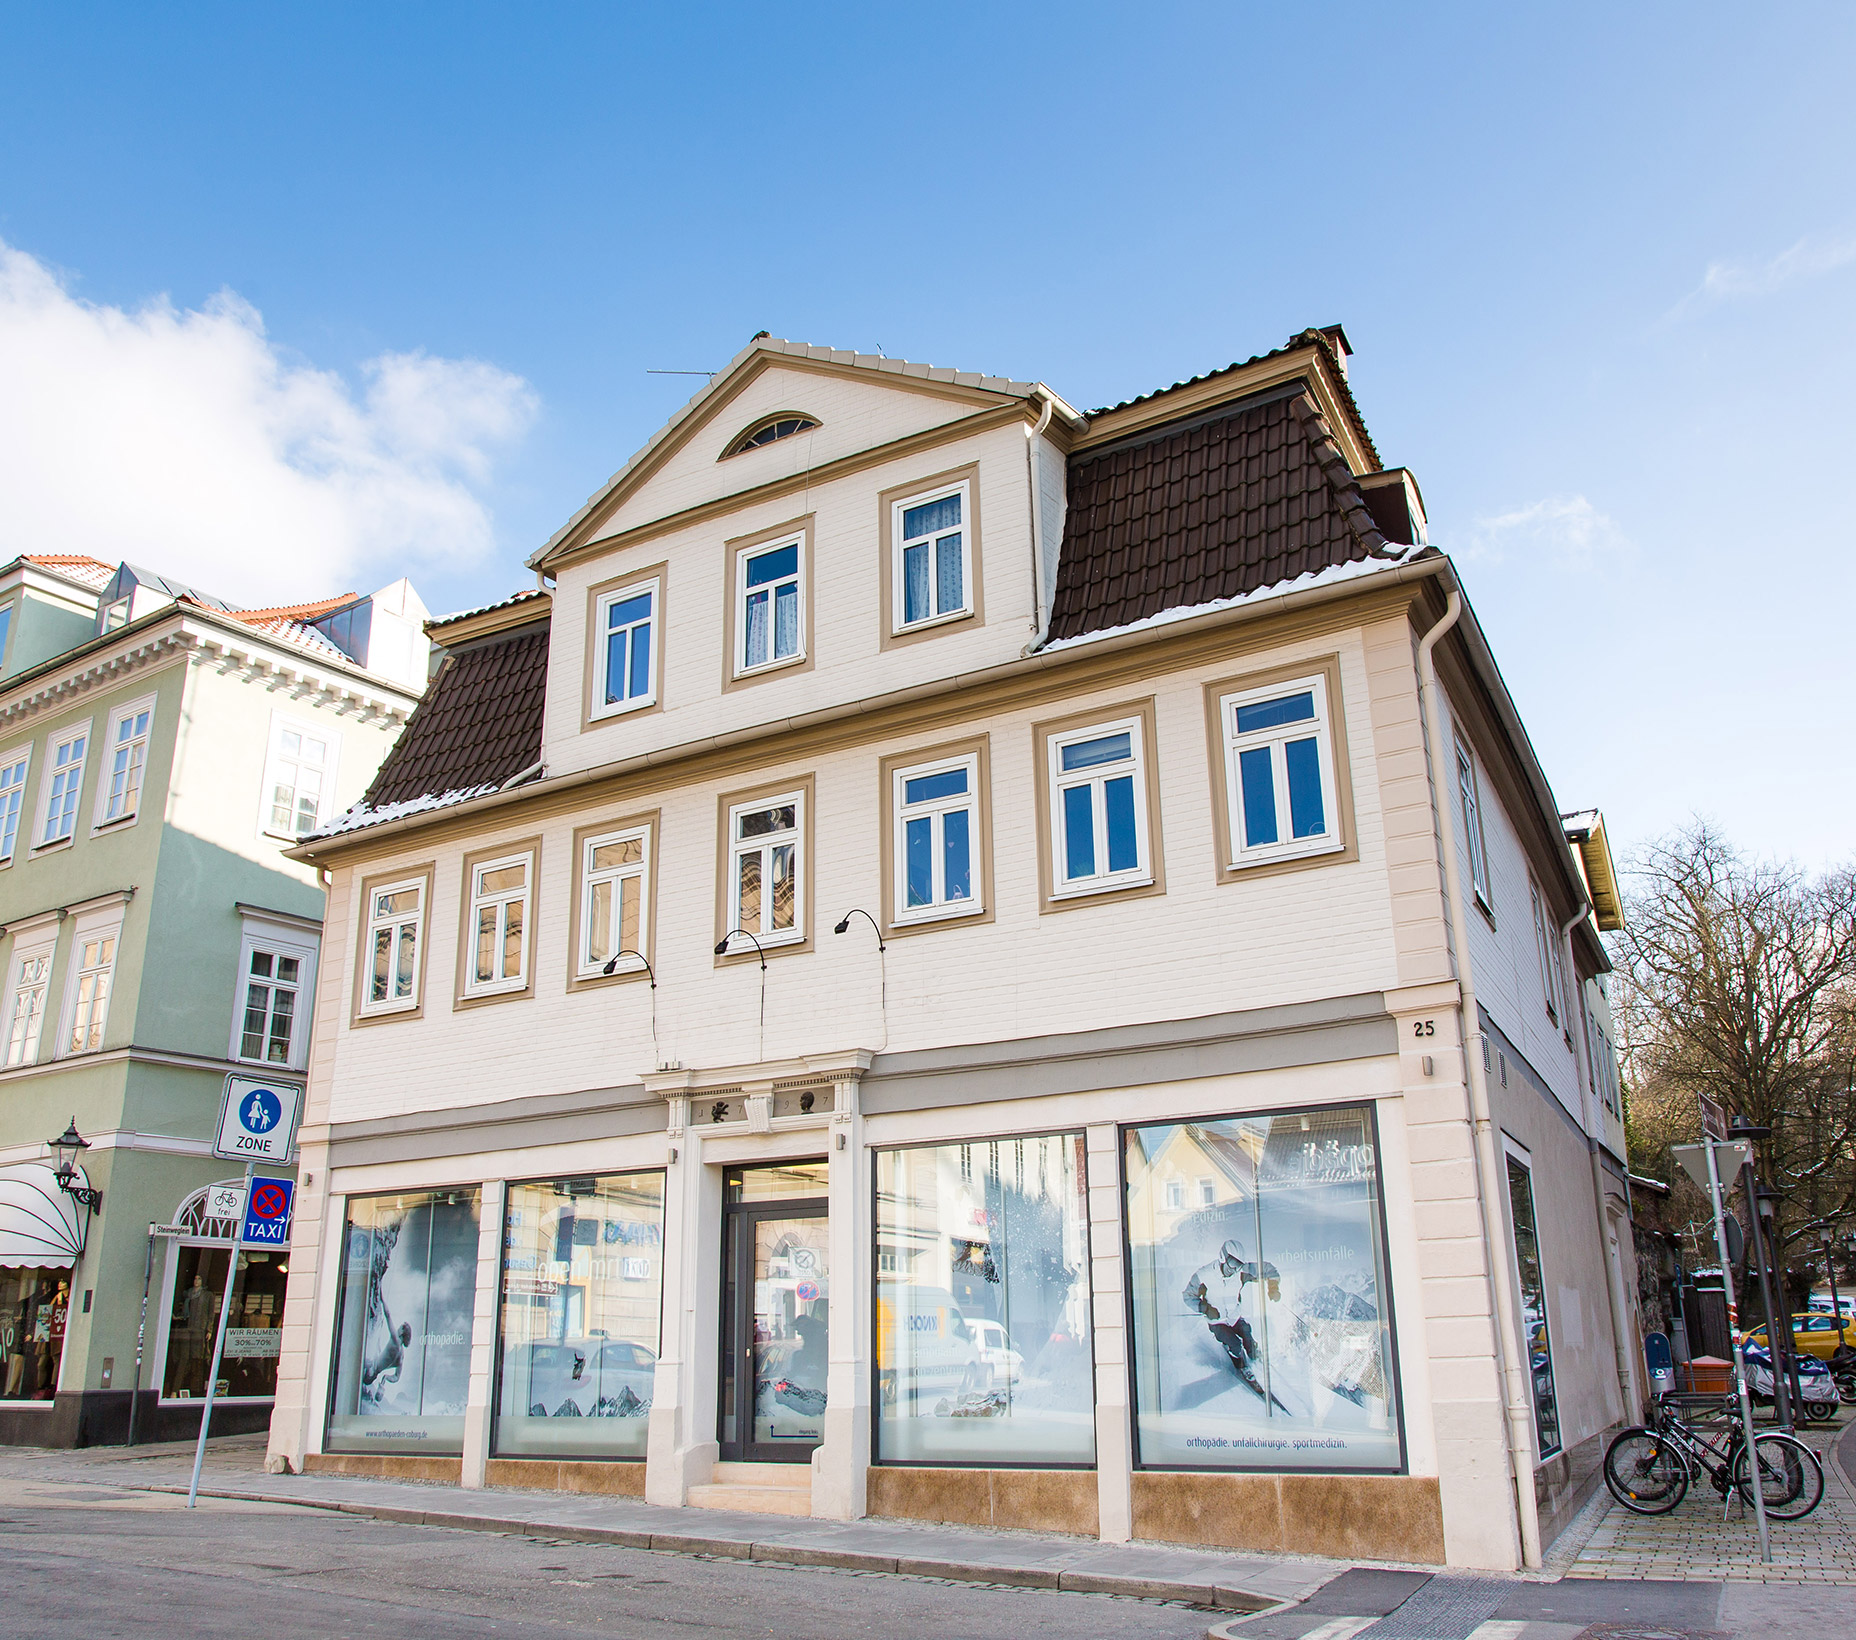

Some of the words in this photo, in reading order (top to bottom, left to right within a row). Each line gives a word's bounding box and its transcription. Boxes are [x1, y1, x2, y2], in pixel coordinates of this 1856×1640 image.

[1413, 1020, 1435, 1037] 25
[236, 1135, 272, 1152] ZONE
[217, 1208, 230, 1217] frei
[248, 1222, 283, 1239] TAXI
[1275, 1245, 1354, 1263] arbeitsunfälle
[538, 1259, 581, 1286] open
[591, 1256, 622, 1281] mrt
[234, 1339, 251, 1347] 30%
[1186, 1436, 1230, 1450] orthopädie.
[1232, 1438, 1290, 1451] unfallchirurgie.
[1292, 1438, 1348, 1451] sportmedizin.
